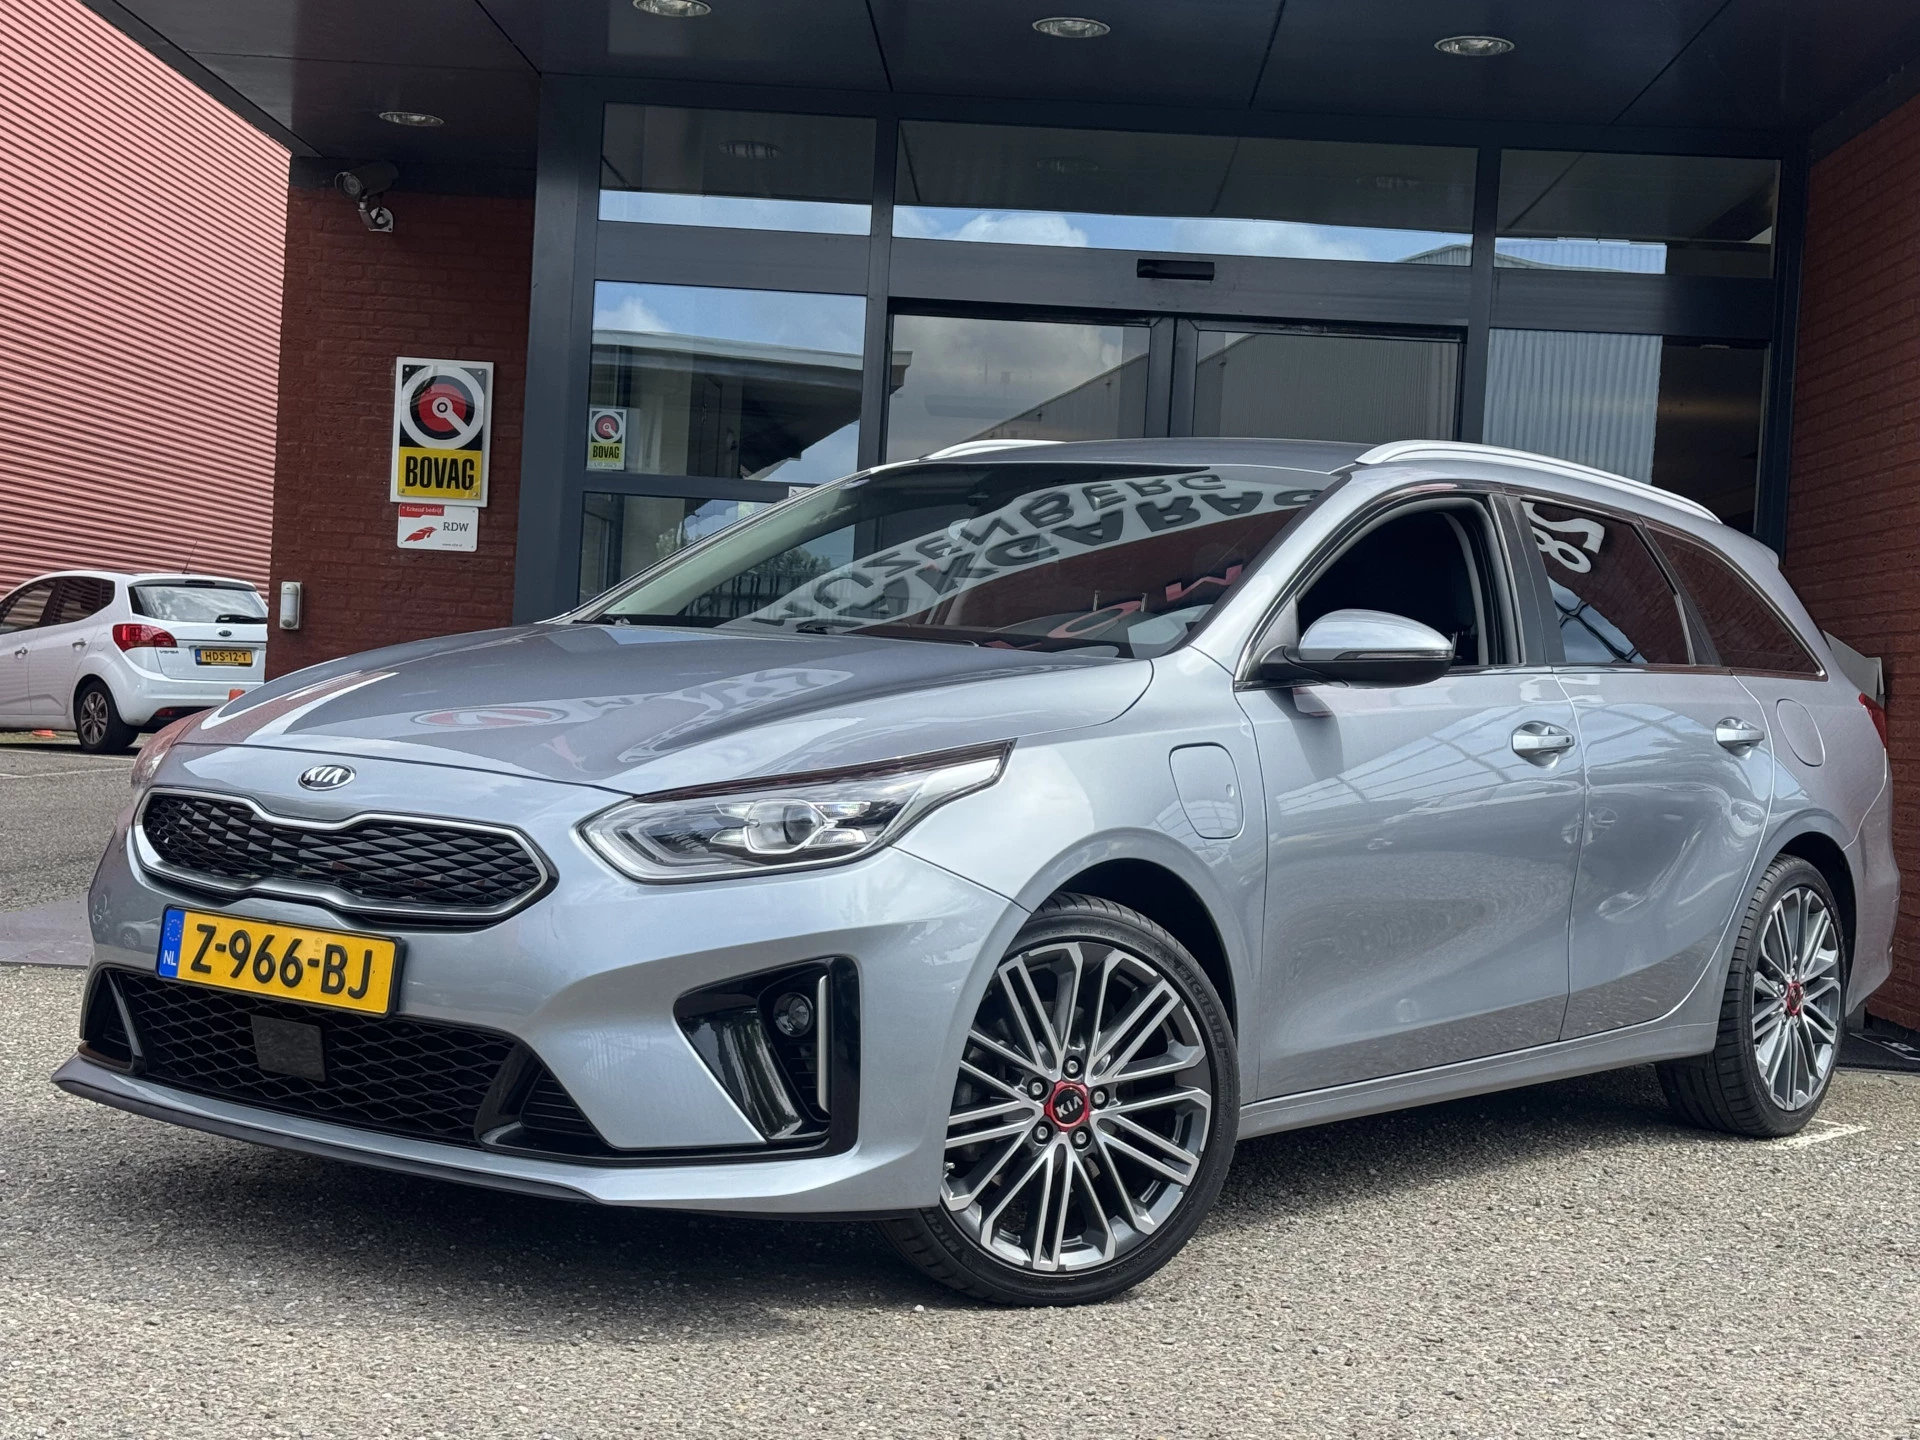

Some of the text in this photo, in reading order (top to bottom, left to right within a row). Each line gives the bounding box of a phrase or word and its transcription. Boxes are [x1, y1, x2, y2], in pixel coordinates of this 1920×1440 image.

[593, 445, 620, 459] BOVAG
[405, 456, 475, 490] BOVAG
[443, 521, 469, 532] RDW
[305, 766, 341, 784] KIA
[163, 950, 177, 966] NL
[190, 923, 373, 999] Z-966-BJ
[1177, 964, 1225, 1046] MICHELIN
[1055, 1095, 1083, 1118] KIA
